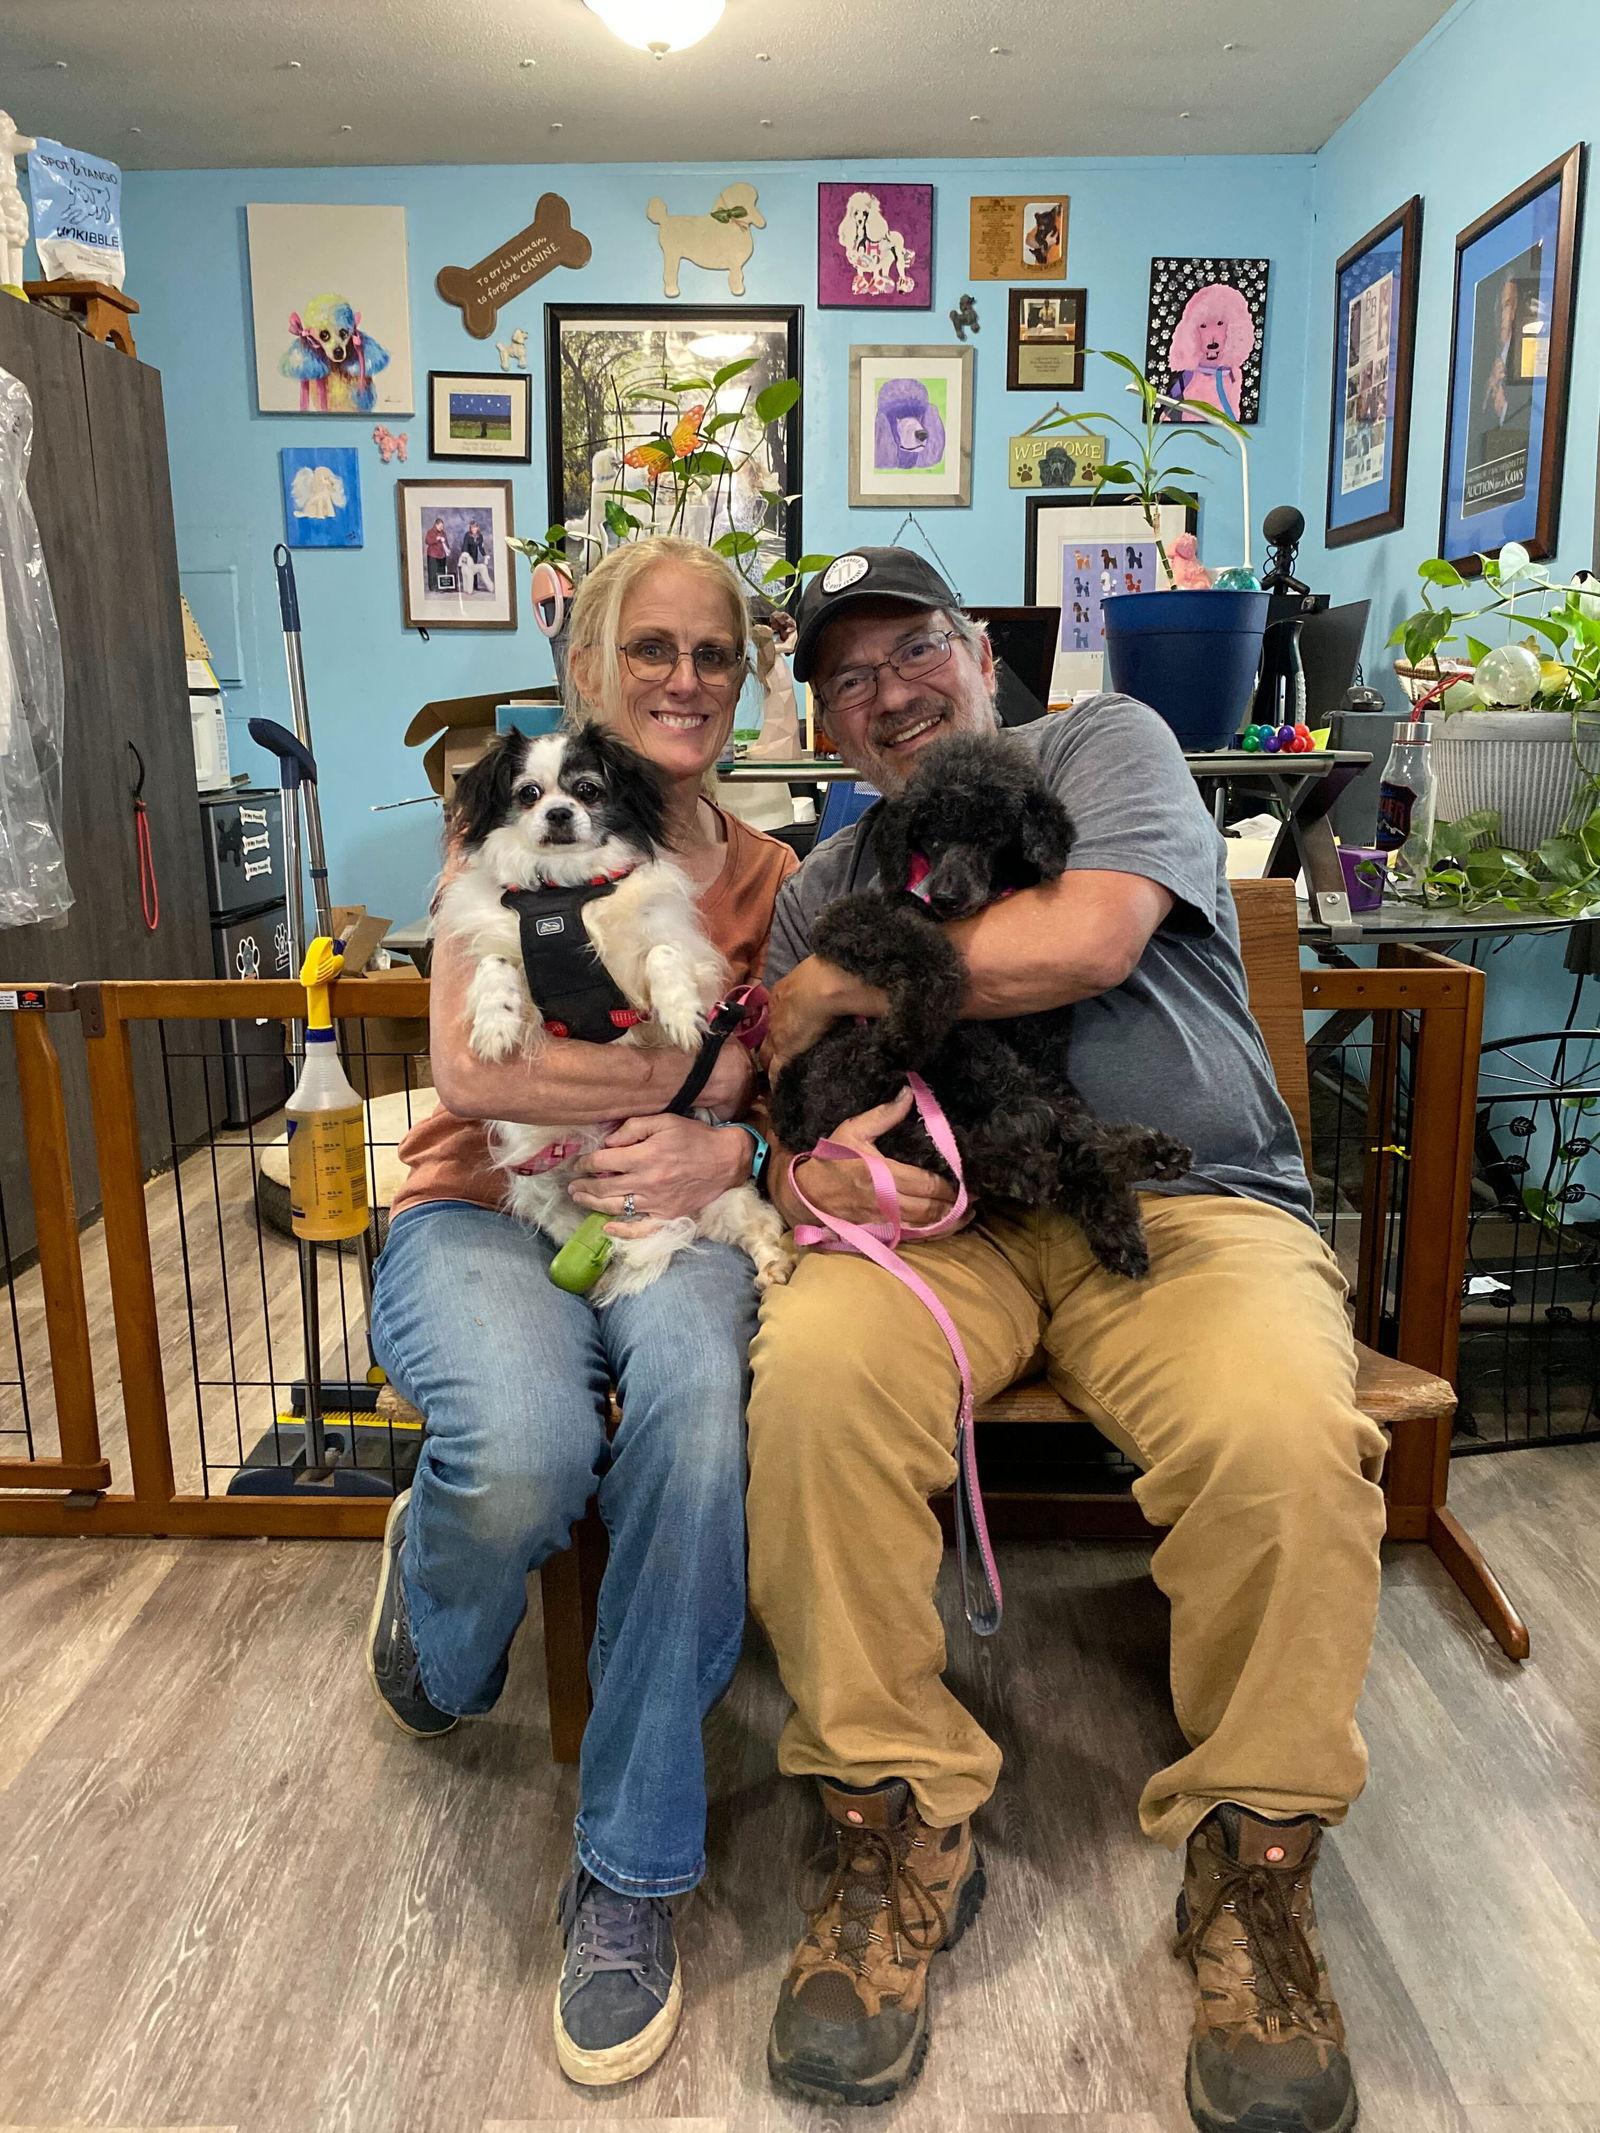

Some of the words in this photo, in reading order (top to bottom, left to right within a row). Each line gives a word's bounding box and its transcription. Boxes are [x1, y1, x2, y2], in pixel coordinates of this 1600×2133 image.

[40, 154, 69, 173] SPOT
[69, 157, 80, 176] &
[81, 165, 118, 185] TANGO
[476, 278, 488, 287] To
[489, 269, 501, 279] err
[500, 260, 511, 270] is
[477, 294, 488, 305] to
[1467, 480, 1494, 498] AUCTION
